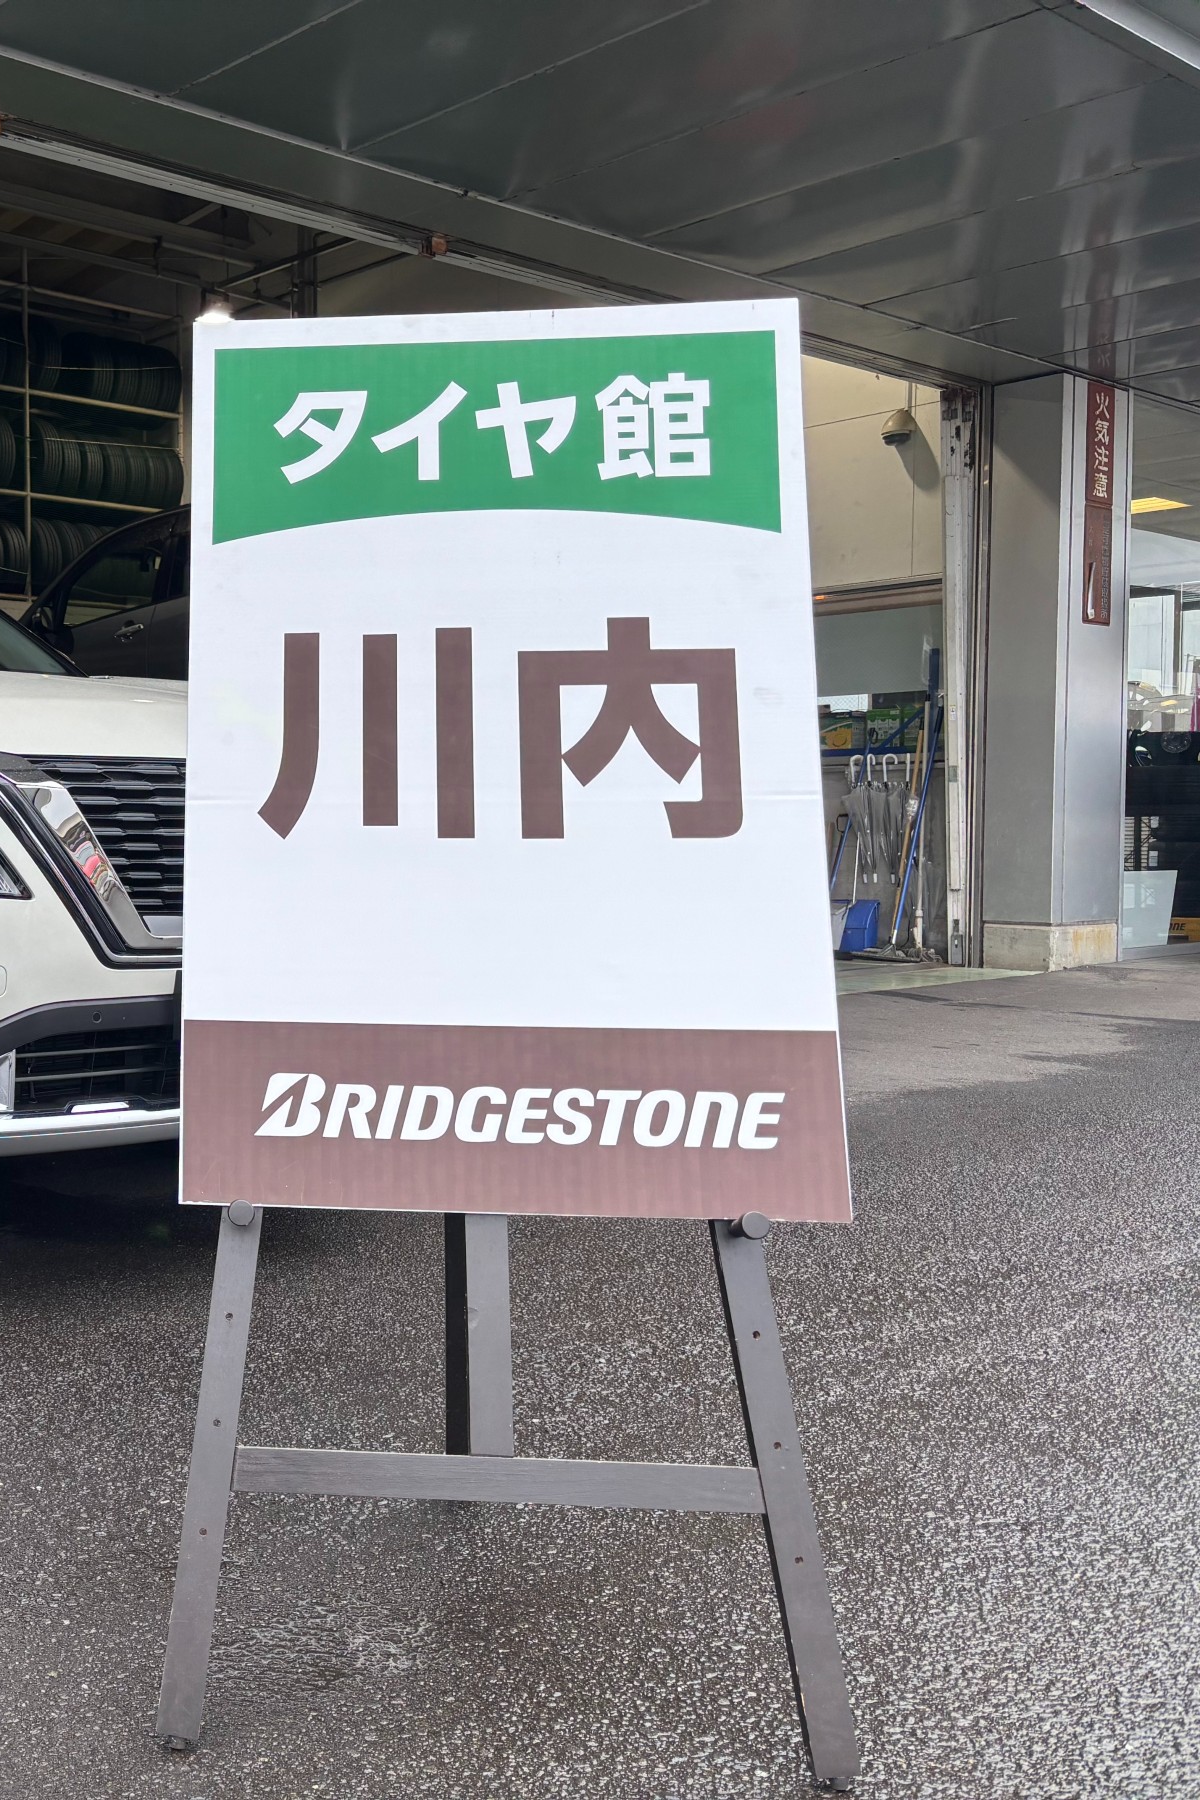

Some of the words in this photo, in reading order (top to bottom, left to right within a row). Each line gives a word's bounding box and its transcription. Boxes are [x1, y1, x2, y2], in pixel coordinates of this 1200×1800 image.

[274, 372, 712, 485] タイヤ館
[1093, 391, 1110, 498] 火気注意
[257, 616, 744, 840] 川内
[254, 1072, 785, 1150] BRIDGESTONE
